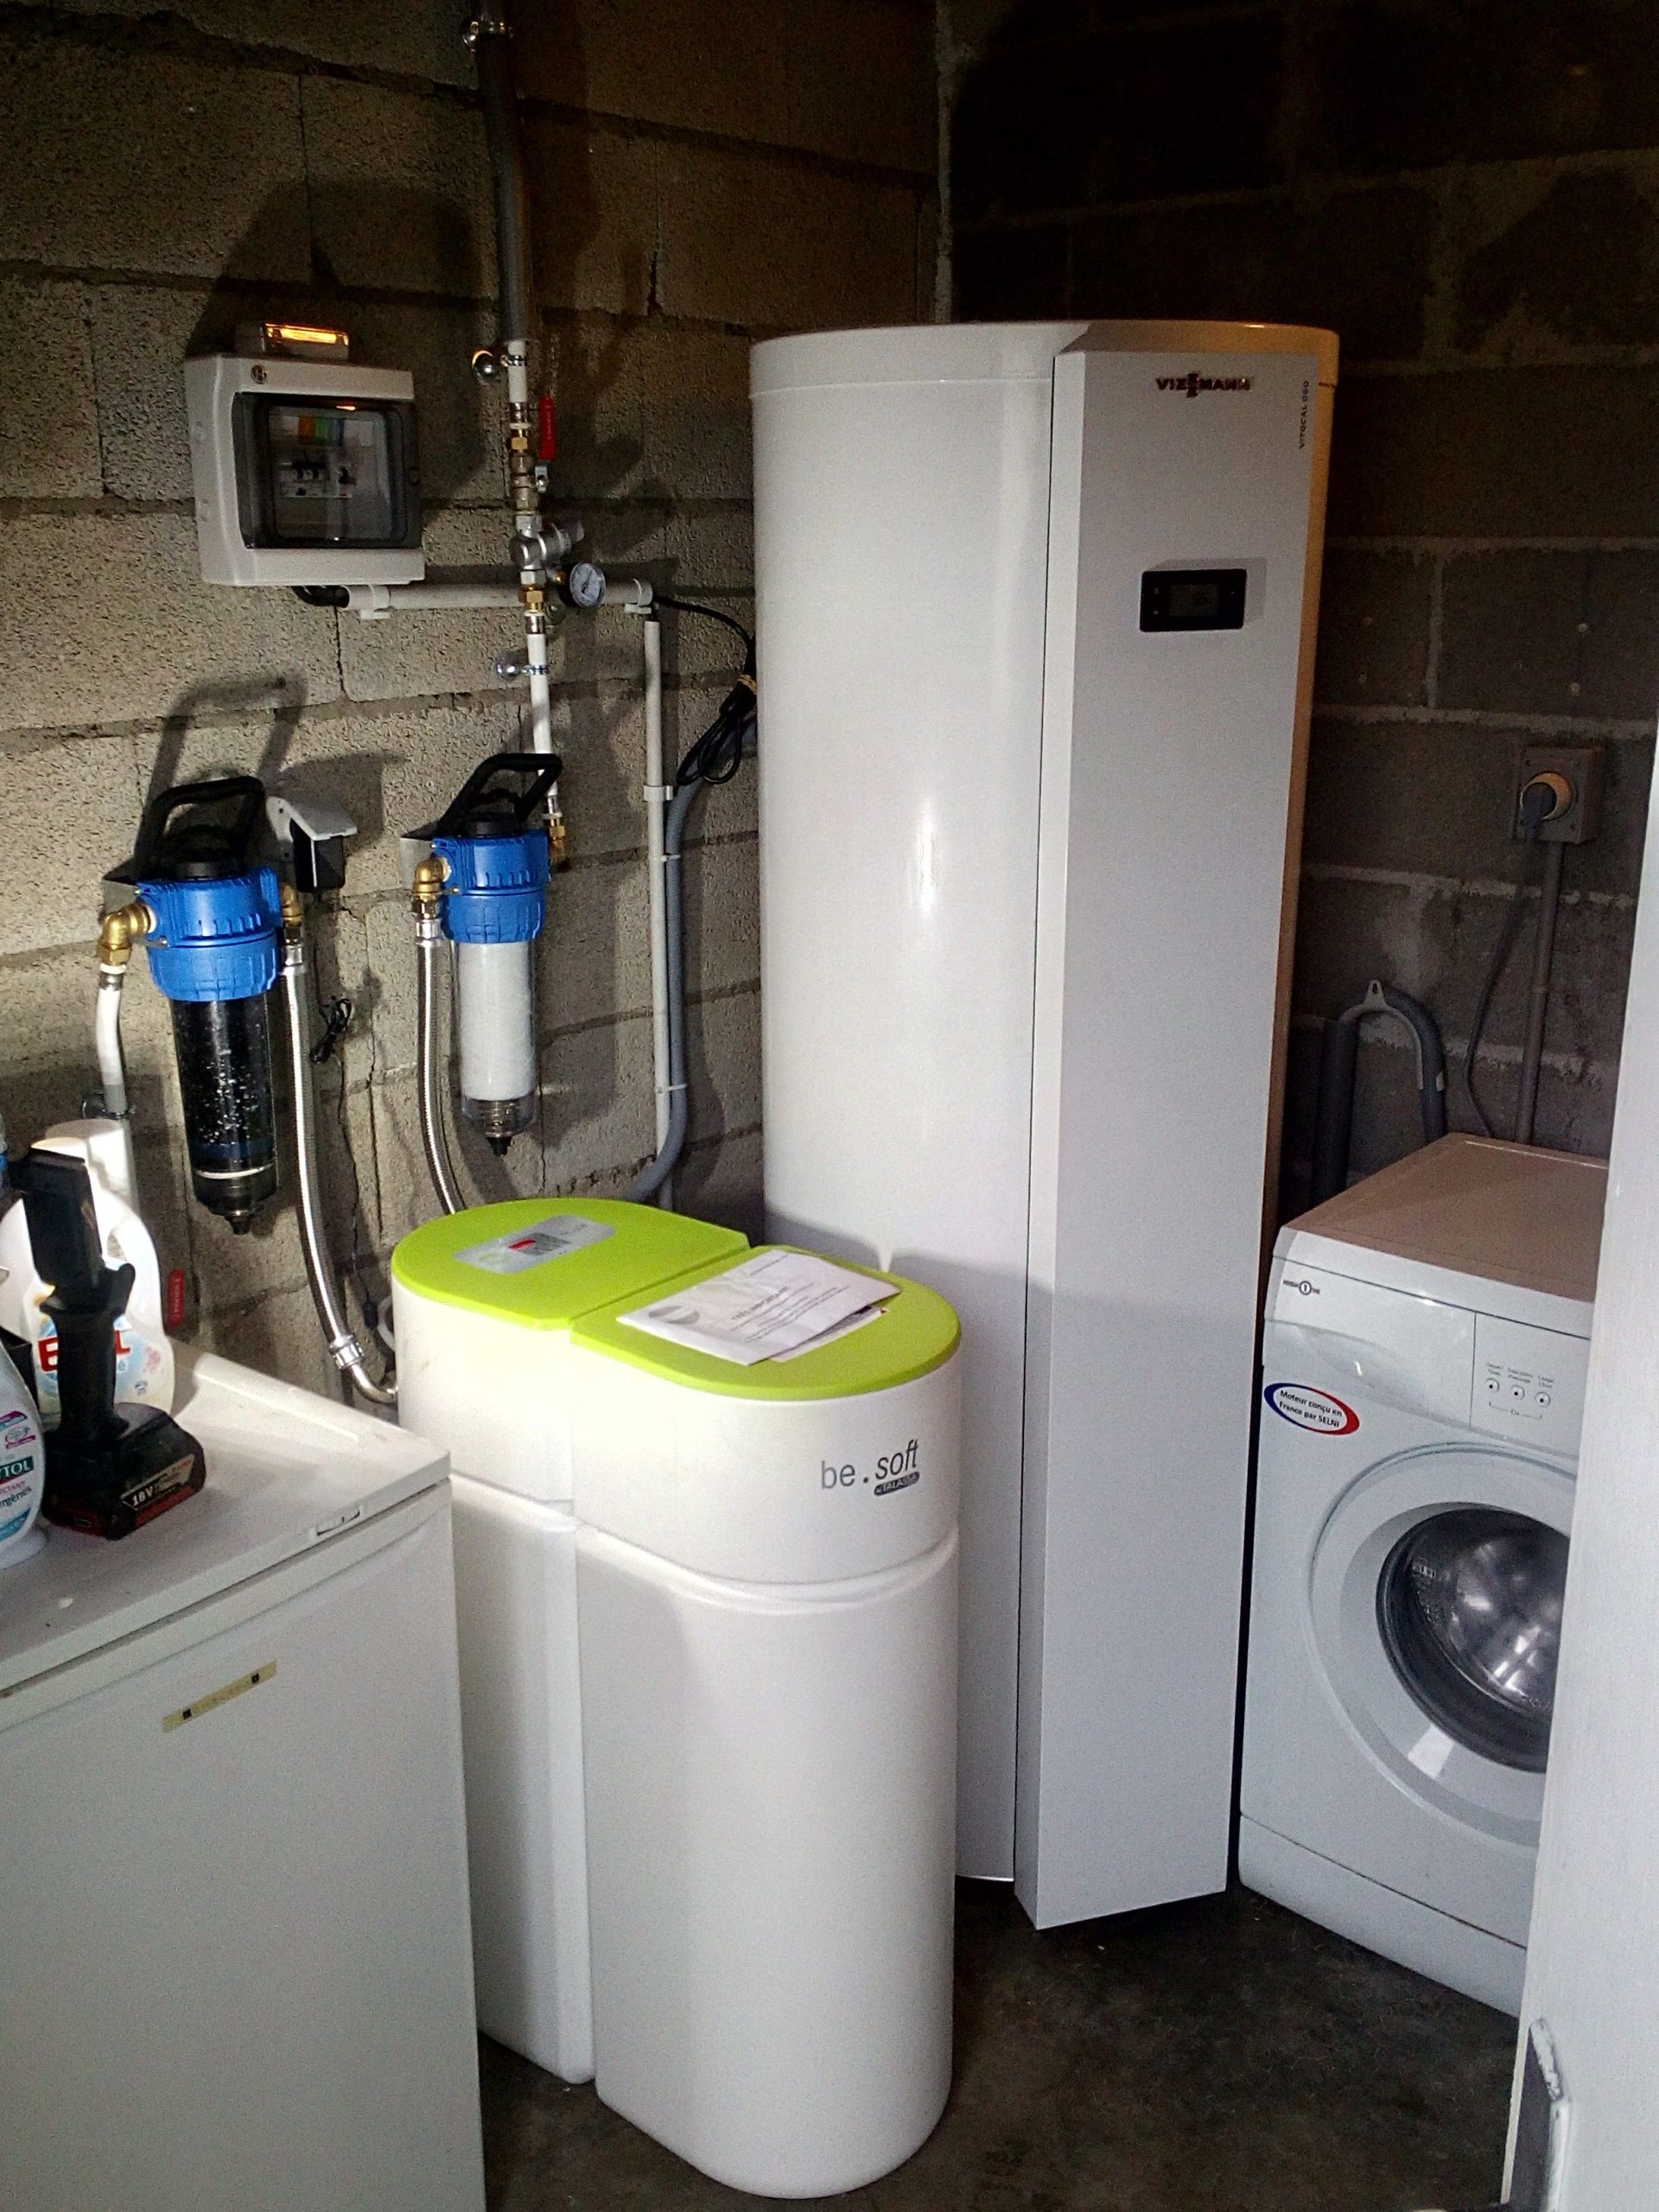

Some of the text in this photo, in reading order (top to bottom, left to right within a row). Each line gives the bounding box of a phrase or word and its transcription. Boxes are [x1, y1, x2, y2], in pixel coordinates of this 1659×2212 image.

[1279, 1401, 1303, 1415] France
[1304, 1411, 1317, 1421] par
[1280, 1389, 1307, 1405] Moteur
[1308, 1400, 1332, 1414] conçu
[131, 1485, 154, 1506] 18V
